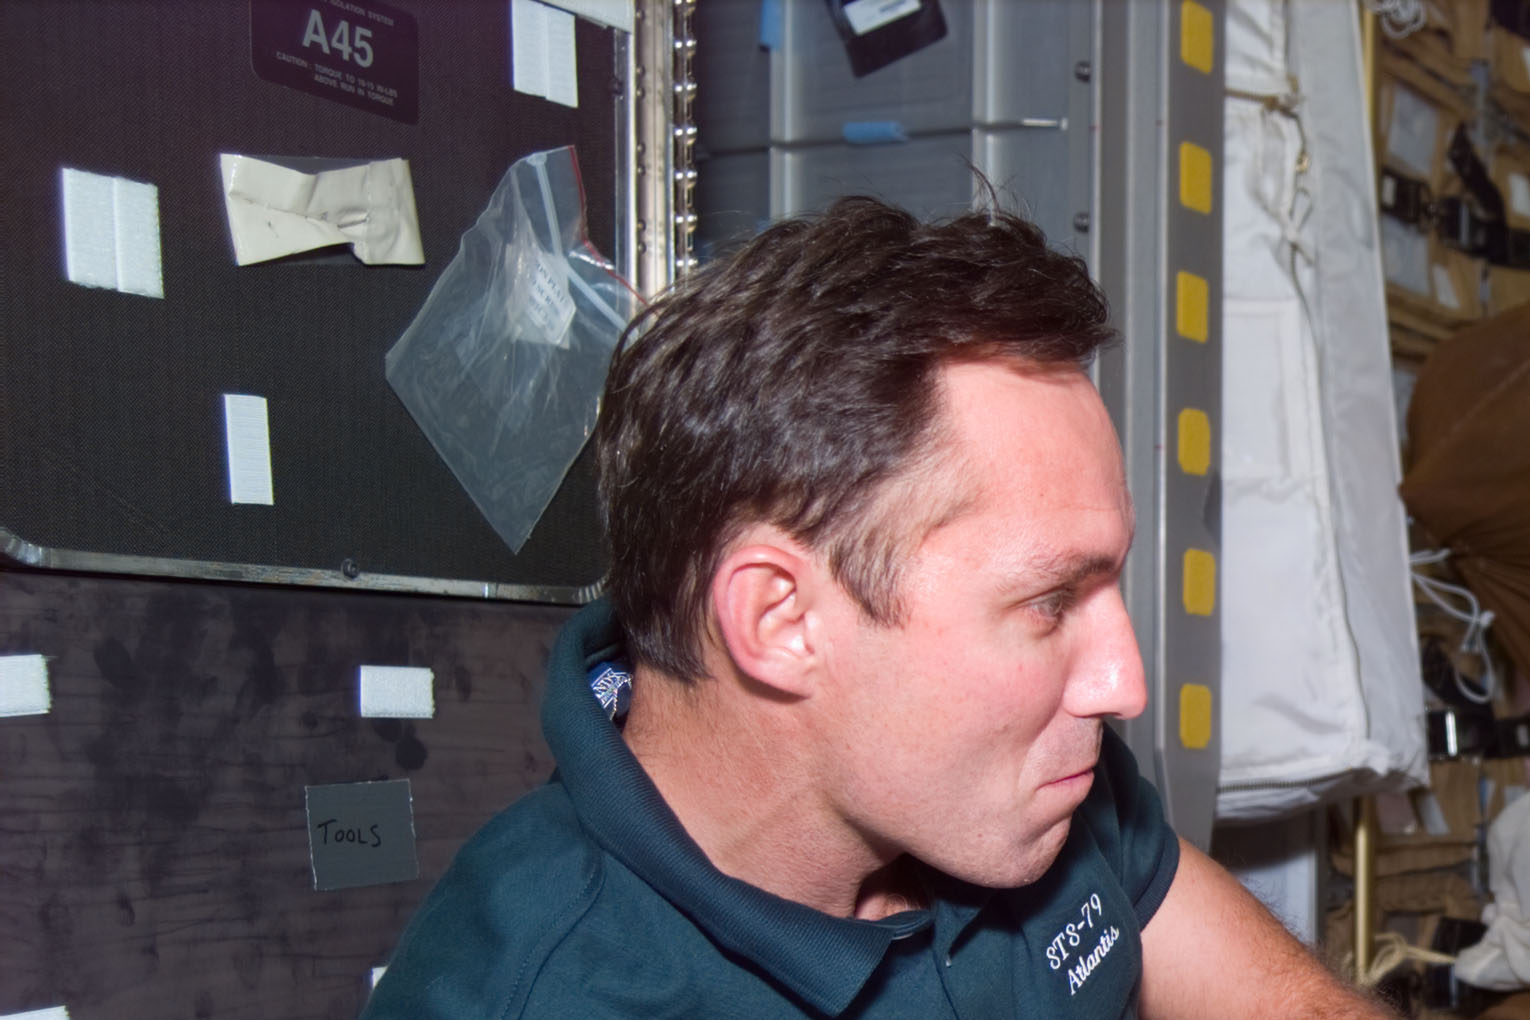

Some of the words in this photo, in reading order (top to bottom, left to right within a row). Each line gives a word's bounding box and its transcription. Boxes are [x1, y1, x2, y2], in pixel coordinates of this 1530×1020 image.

[302, 8, 374, 68] A45
[367, 10, 395, 27] SYSTEM
[314, 63, 343, 81] TORQUE
[345, 73, 356, 84] TO
[367, 91, 395, 106] TORQUE
[1046, 893, 1102, 970] STS-79
[1067, 925, 1120, 996] Atlantis
